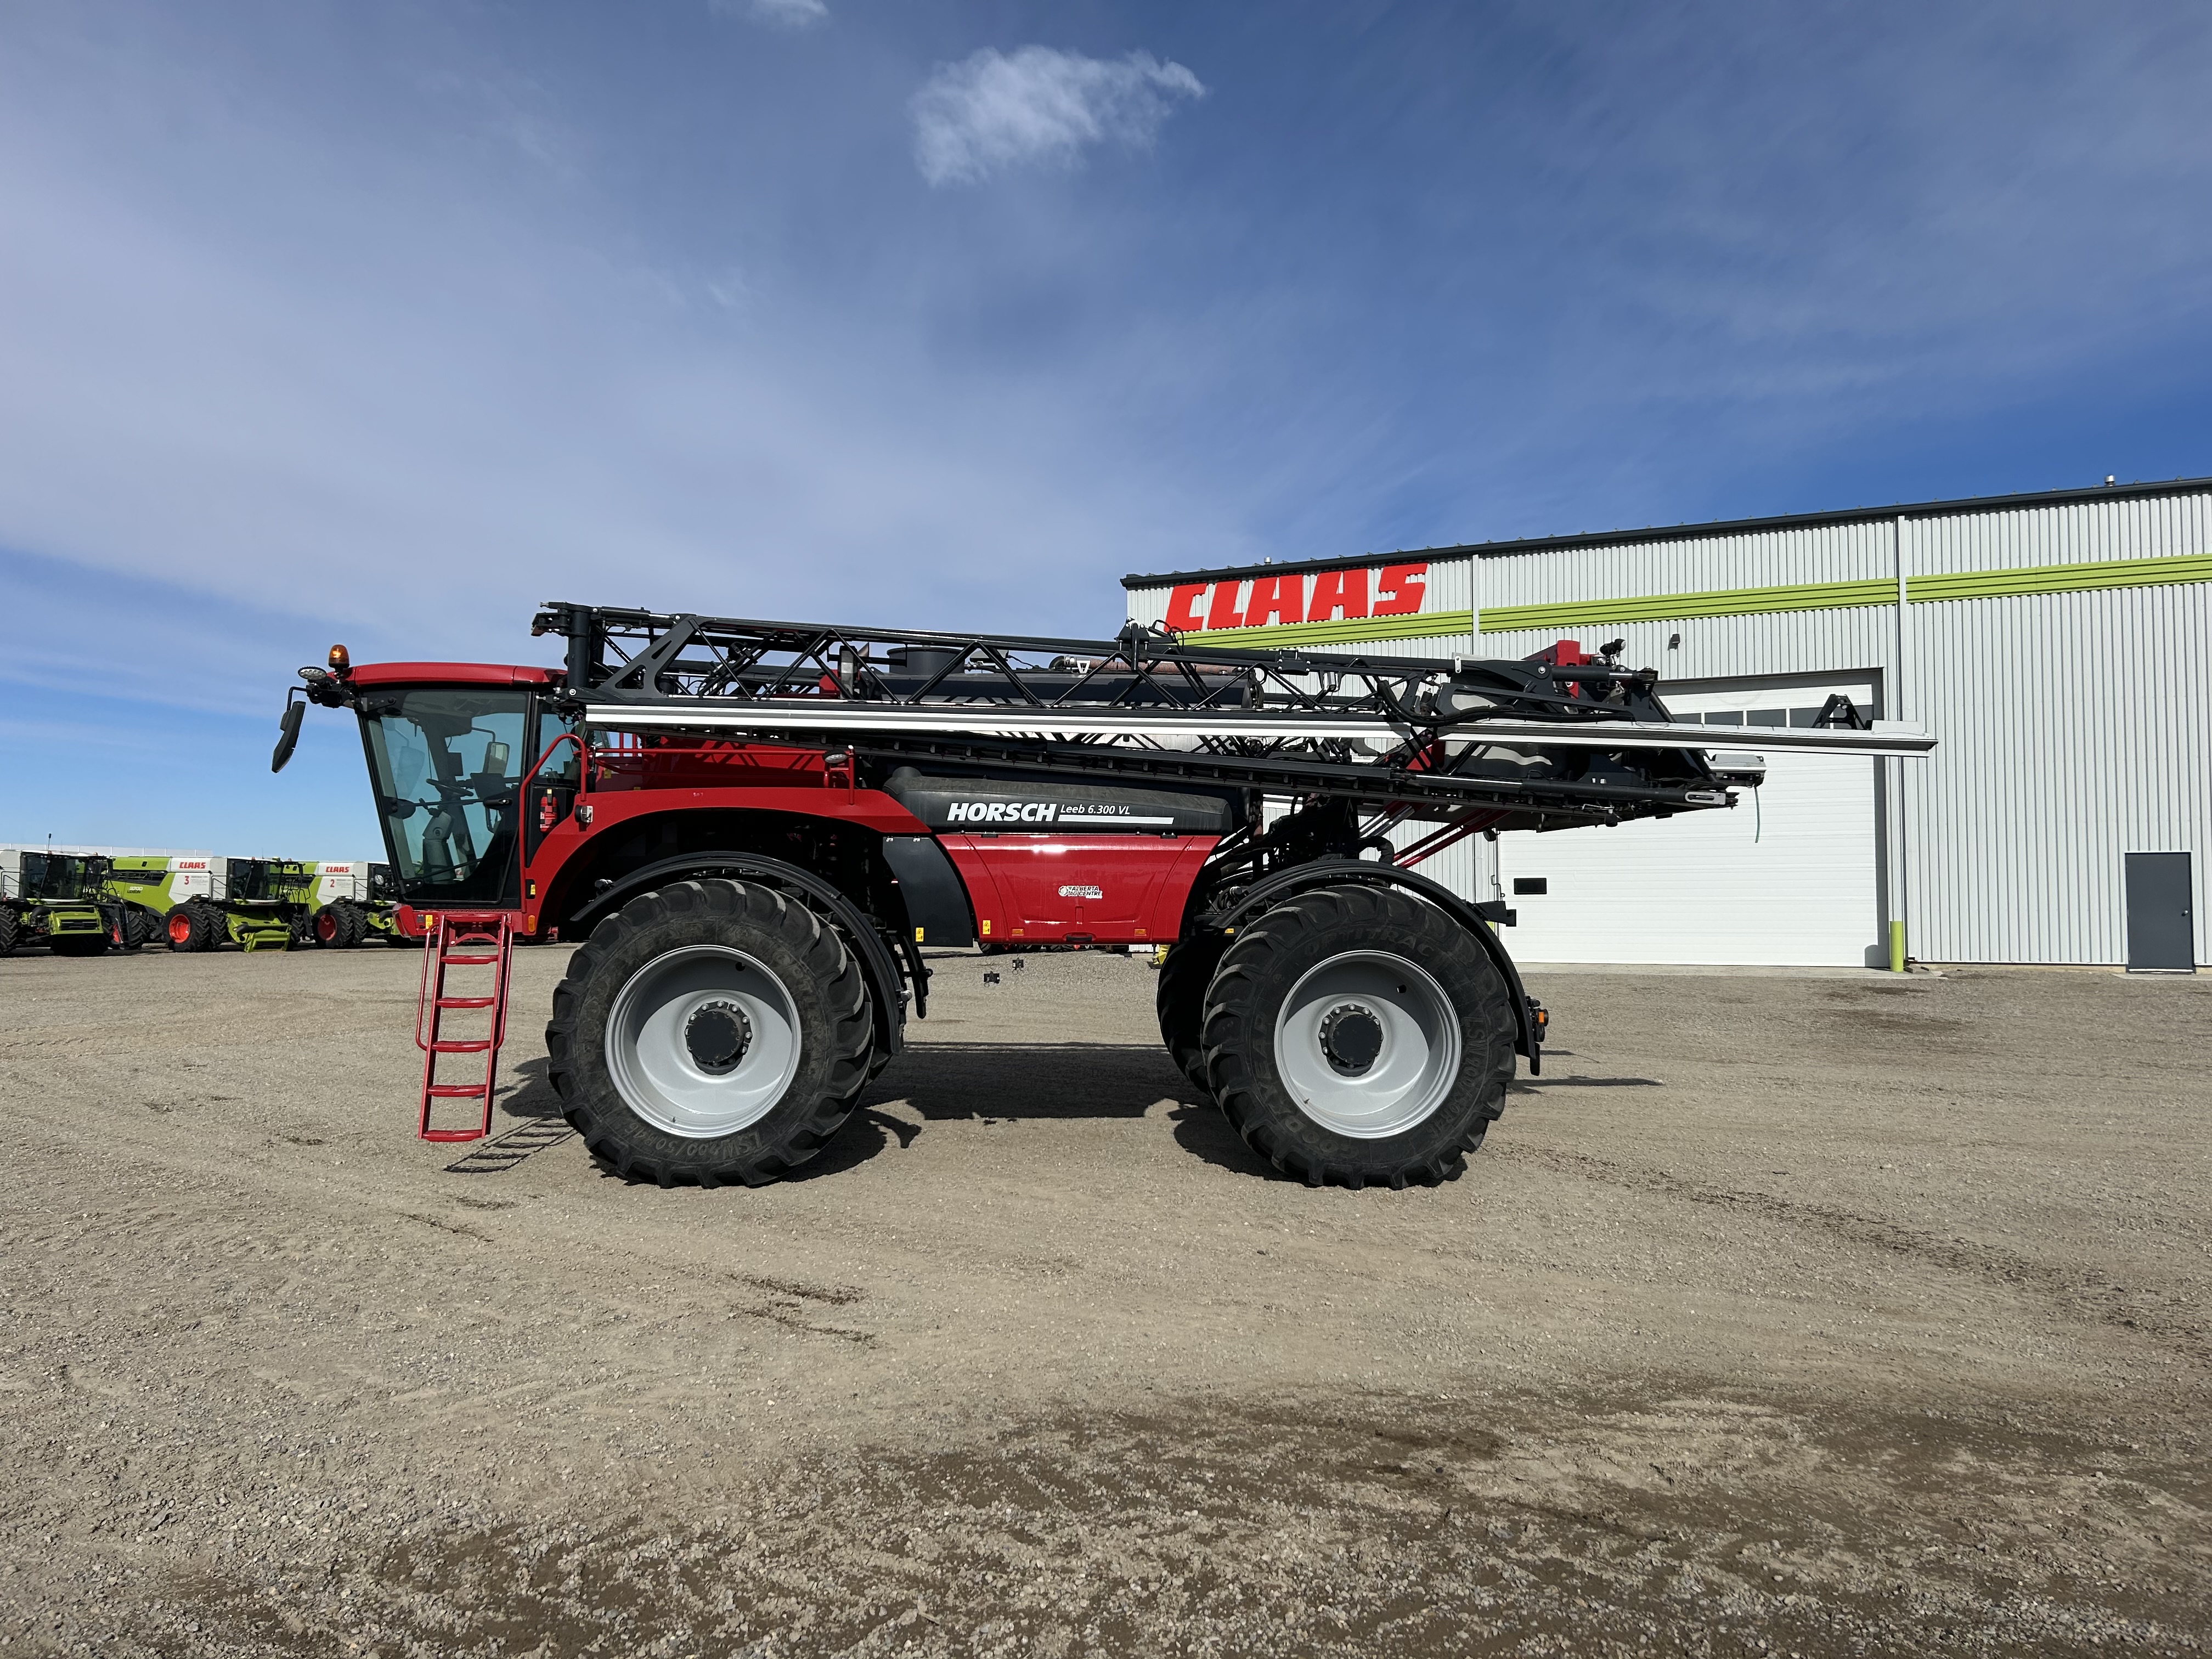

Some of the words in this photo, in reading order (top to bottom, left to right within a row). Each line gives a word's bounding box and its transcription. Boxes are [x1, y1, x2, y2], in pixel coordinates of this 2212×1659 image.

[1164, 563, 1428, 633] CLAAS
[947, 803, 1057, 822] HORSCH
[1060, 804, 1085, 813] Leeb
[1088, 805, 1115, 815] 6.300
[1119, 805, 1131, 815] VL
[184, 876, 190, 885] 3
[330, 879, 335, 888] 2
